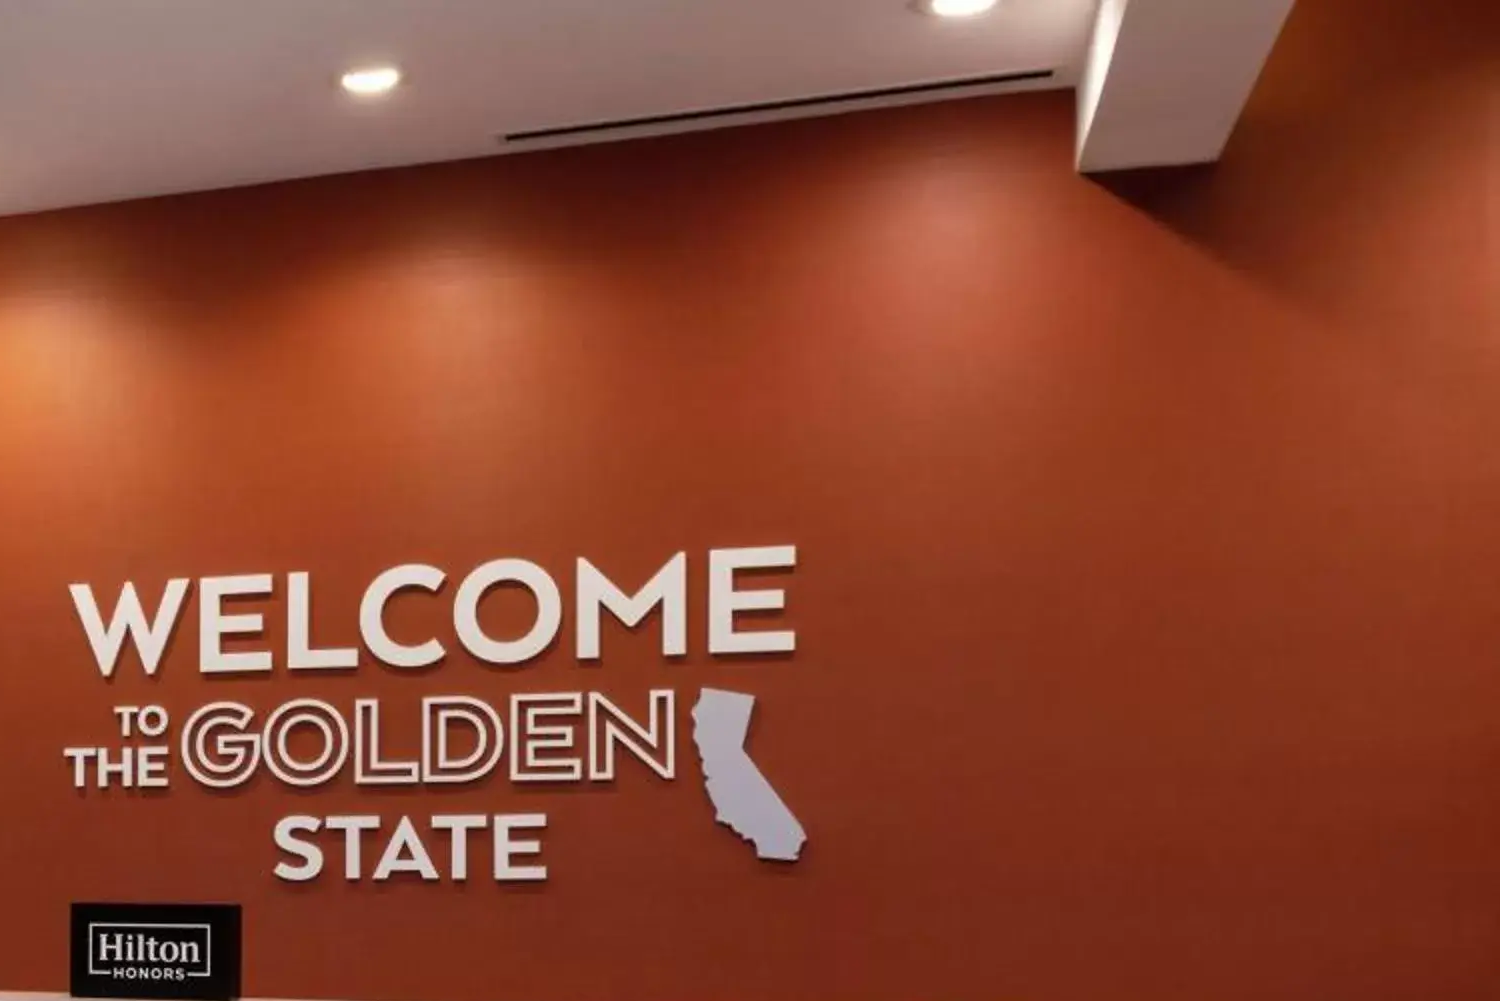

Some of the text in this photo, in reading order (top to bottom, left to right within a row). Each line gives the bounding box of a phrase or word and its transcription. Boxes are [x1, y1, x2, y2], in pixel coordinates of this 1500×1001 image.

[69, 545, 797, 677] WELCOME
[63, 689, 676, 788] THE GOLDEN
[114, 705, 169, 737] TO
[273, 813, 547, 881] STATE
[99, 933, 200, 963] Hilton
[113, 967, 186, 981] HONORS
